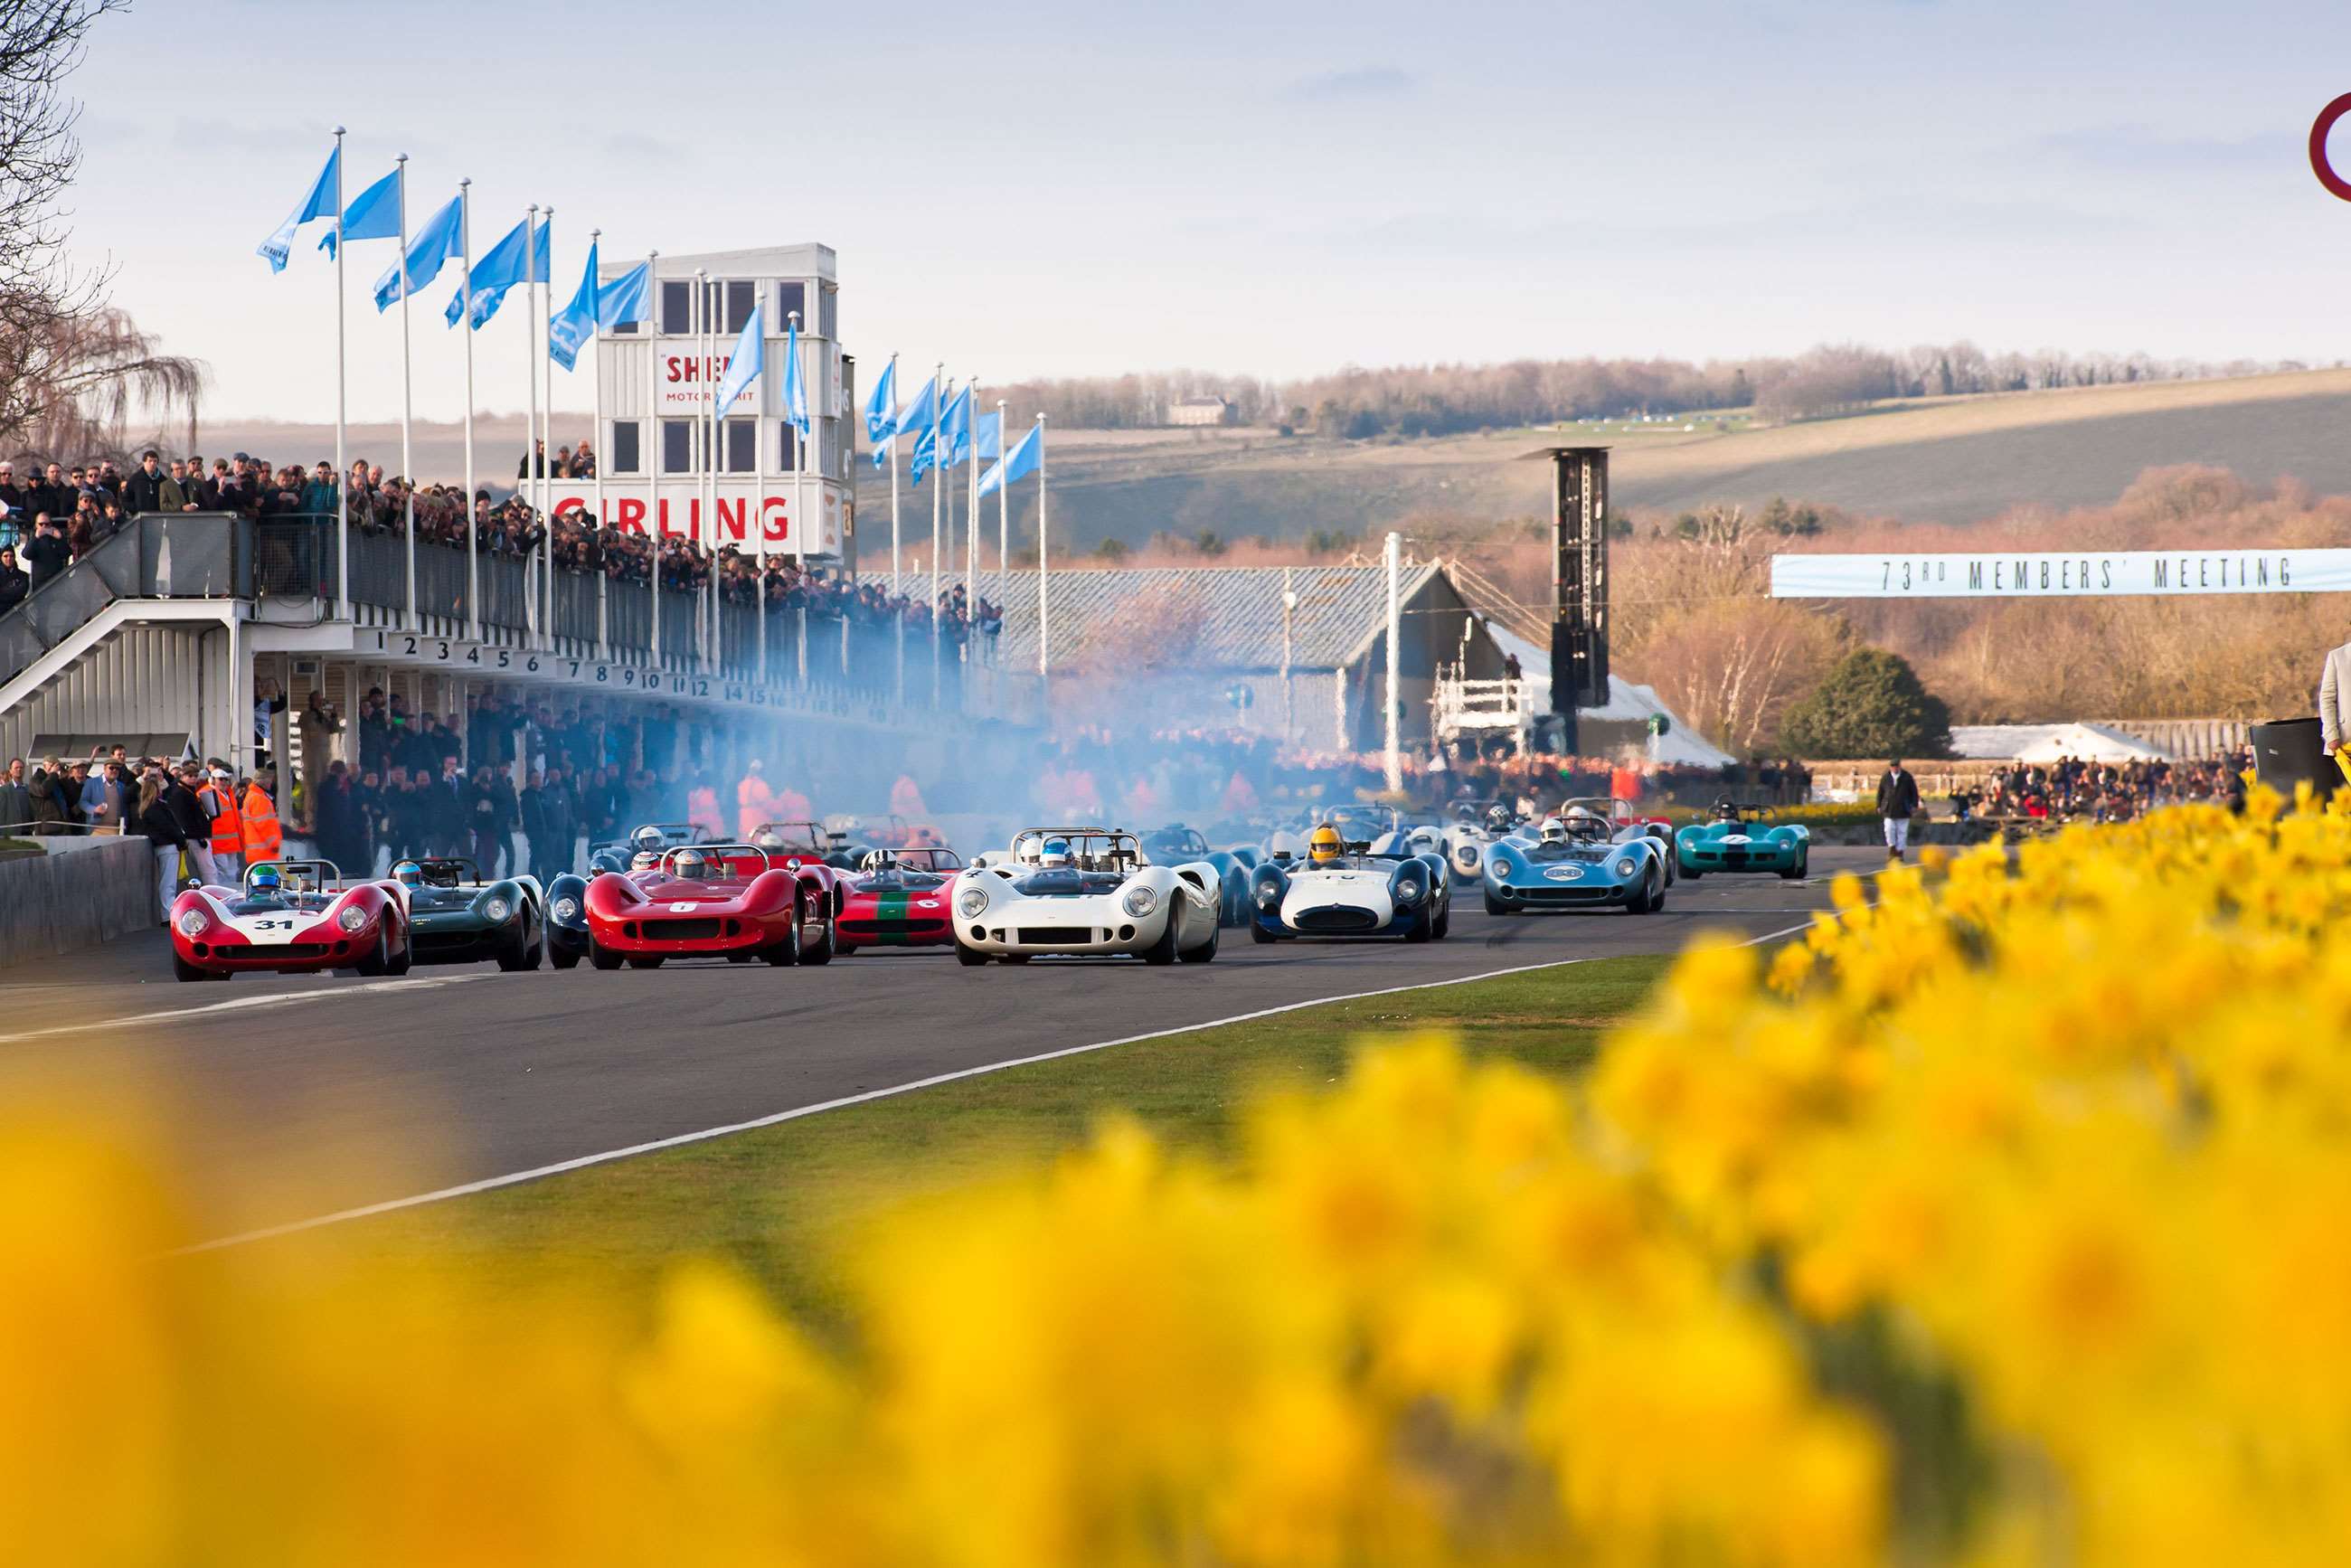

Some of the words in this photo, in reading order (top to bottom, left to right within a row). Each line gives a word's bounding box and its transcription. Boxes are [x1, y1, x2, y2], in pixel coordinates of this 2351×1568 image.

[666, 356, 752, 383] SHE
[1883, 562, 1945, 590] 73RD
[2155, 557, 2290, 589] MEETING
[378, 631, 383, 649] 1
[404, 638, 417, 655] 2
[438, 642, 448, 659] 3
[467, 647, 478, 664] 4
[497, 651, 509, 667] 5
[526, 656, 539, 672] 6
[569, 662, 579, 677] 7
[597, 666, 608, 682] 8
[624, 670, 633, 685] 9
[642, 674, 659, 689] 10
[673, 677, 685, 693] 11
[692, 681, 709, 696] 12
[725, 685, 742, 701] 14
[750, 689, 766, 704] 15
[254, 920, 294, 930] 31
